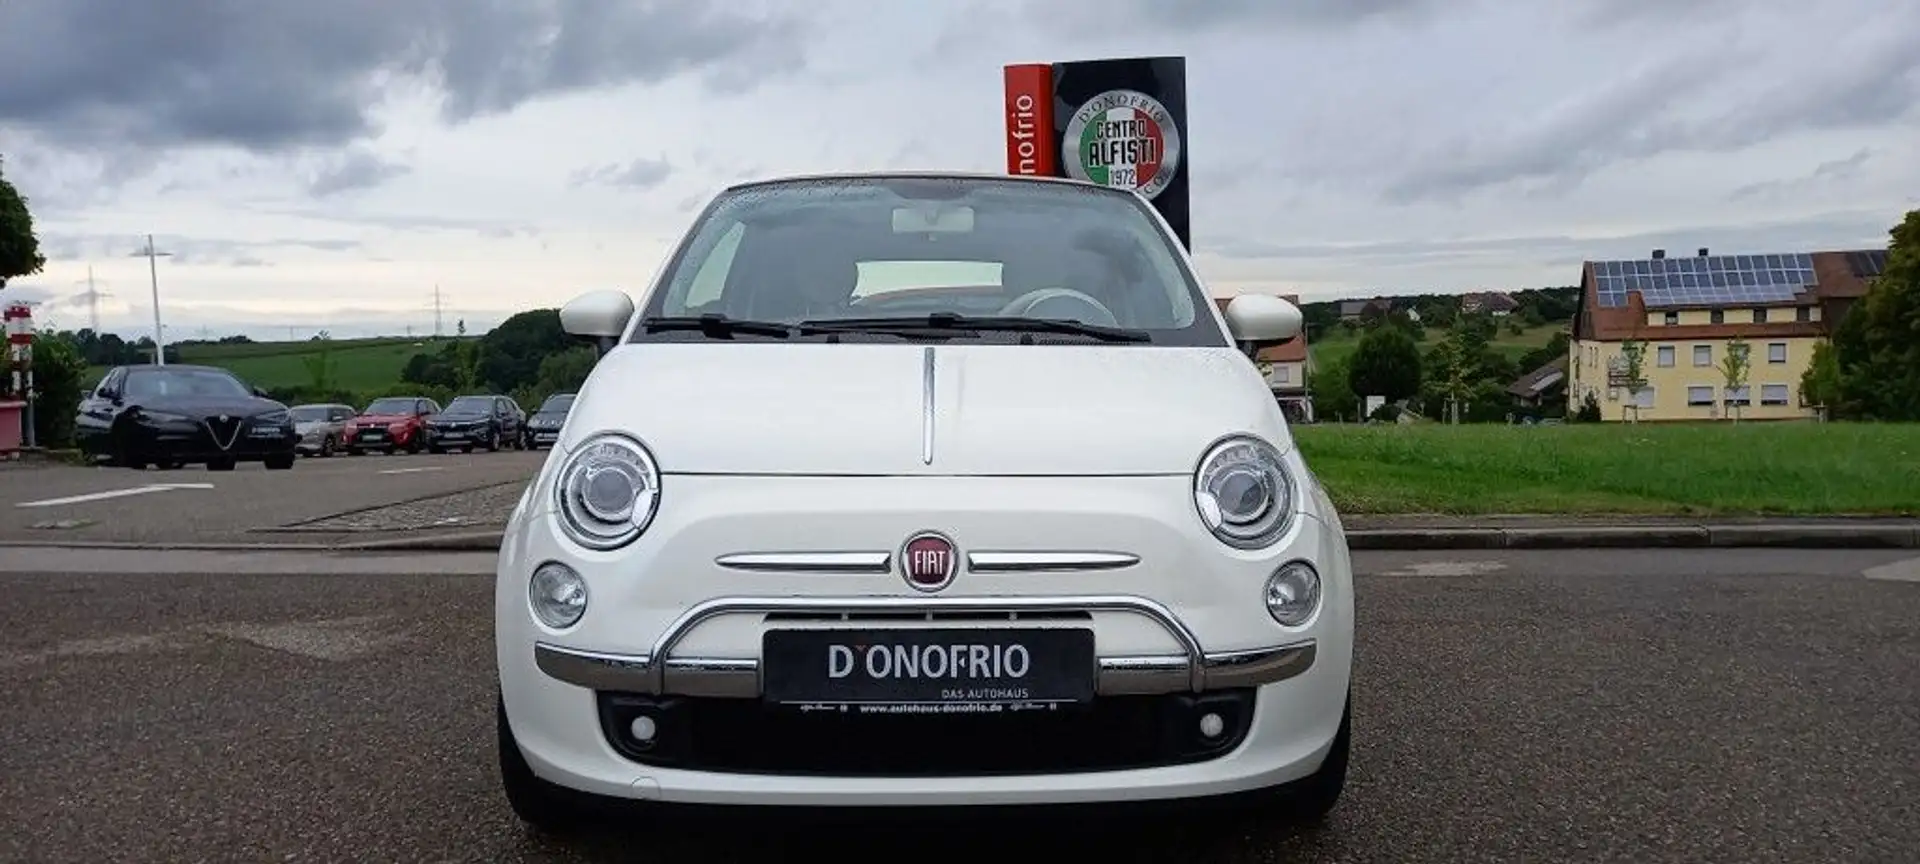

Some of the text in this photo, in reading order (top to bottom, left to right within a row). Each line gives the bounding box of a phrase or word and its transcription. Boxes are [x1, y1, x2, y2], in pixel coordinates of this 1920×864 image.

[1096, 120, 1146, 138] CENTRO
[1088, 138, 1156, 167] ALFISTI
[1110, 168, 1136, 185] 1972
[914, 550, 946, 575] FIAT
[941, 688, 1029, 699] DAS AUTOHAUS
[860, 702, 1003, 713] www.autohaus-donofrio.de
